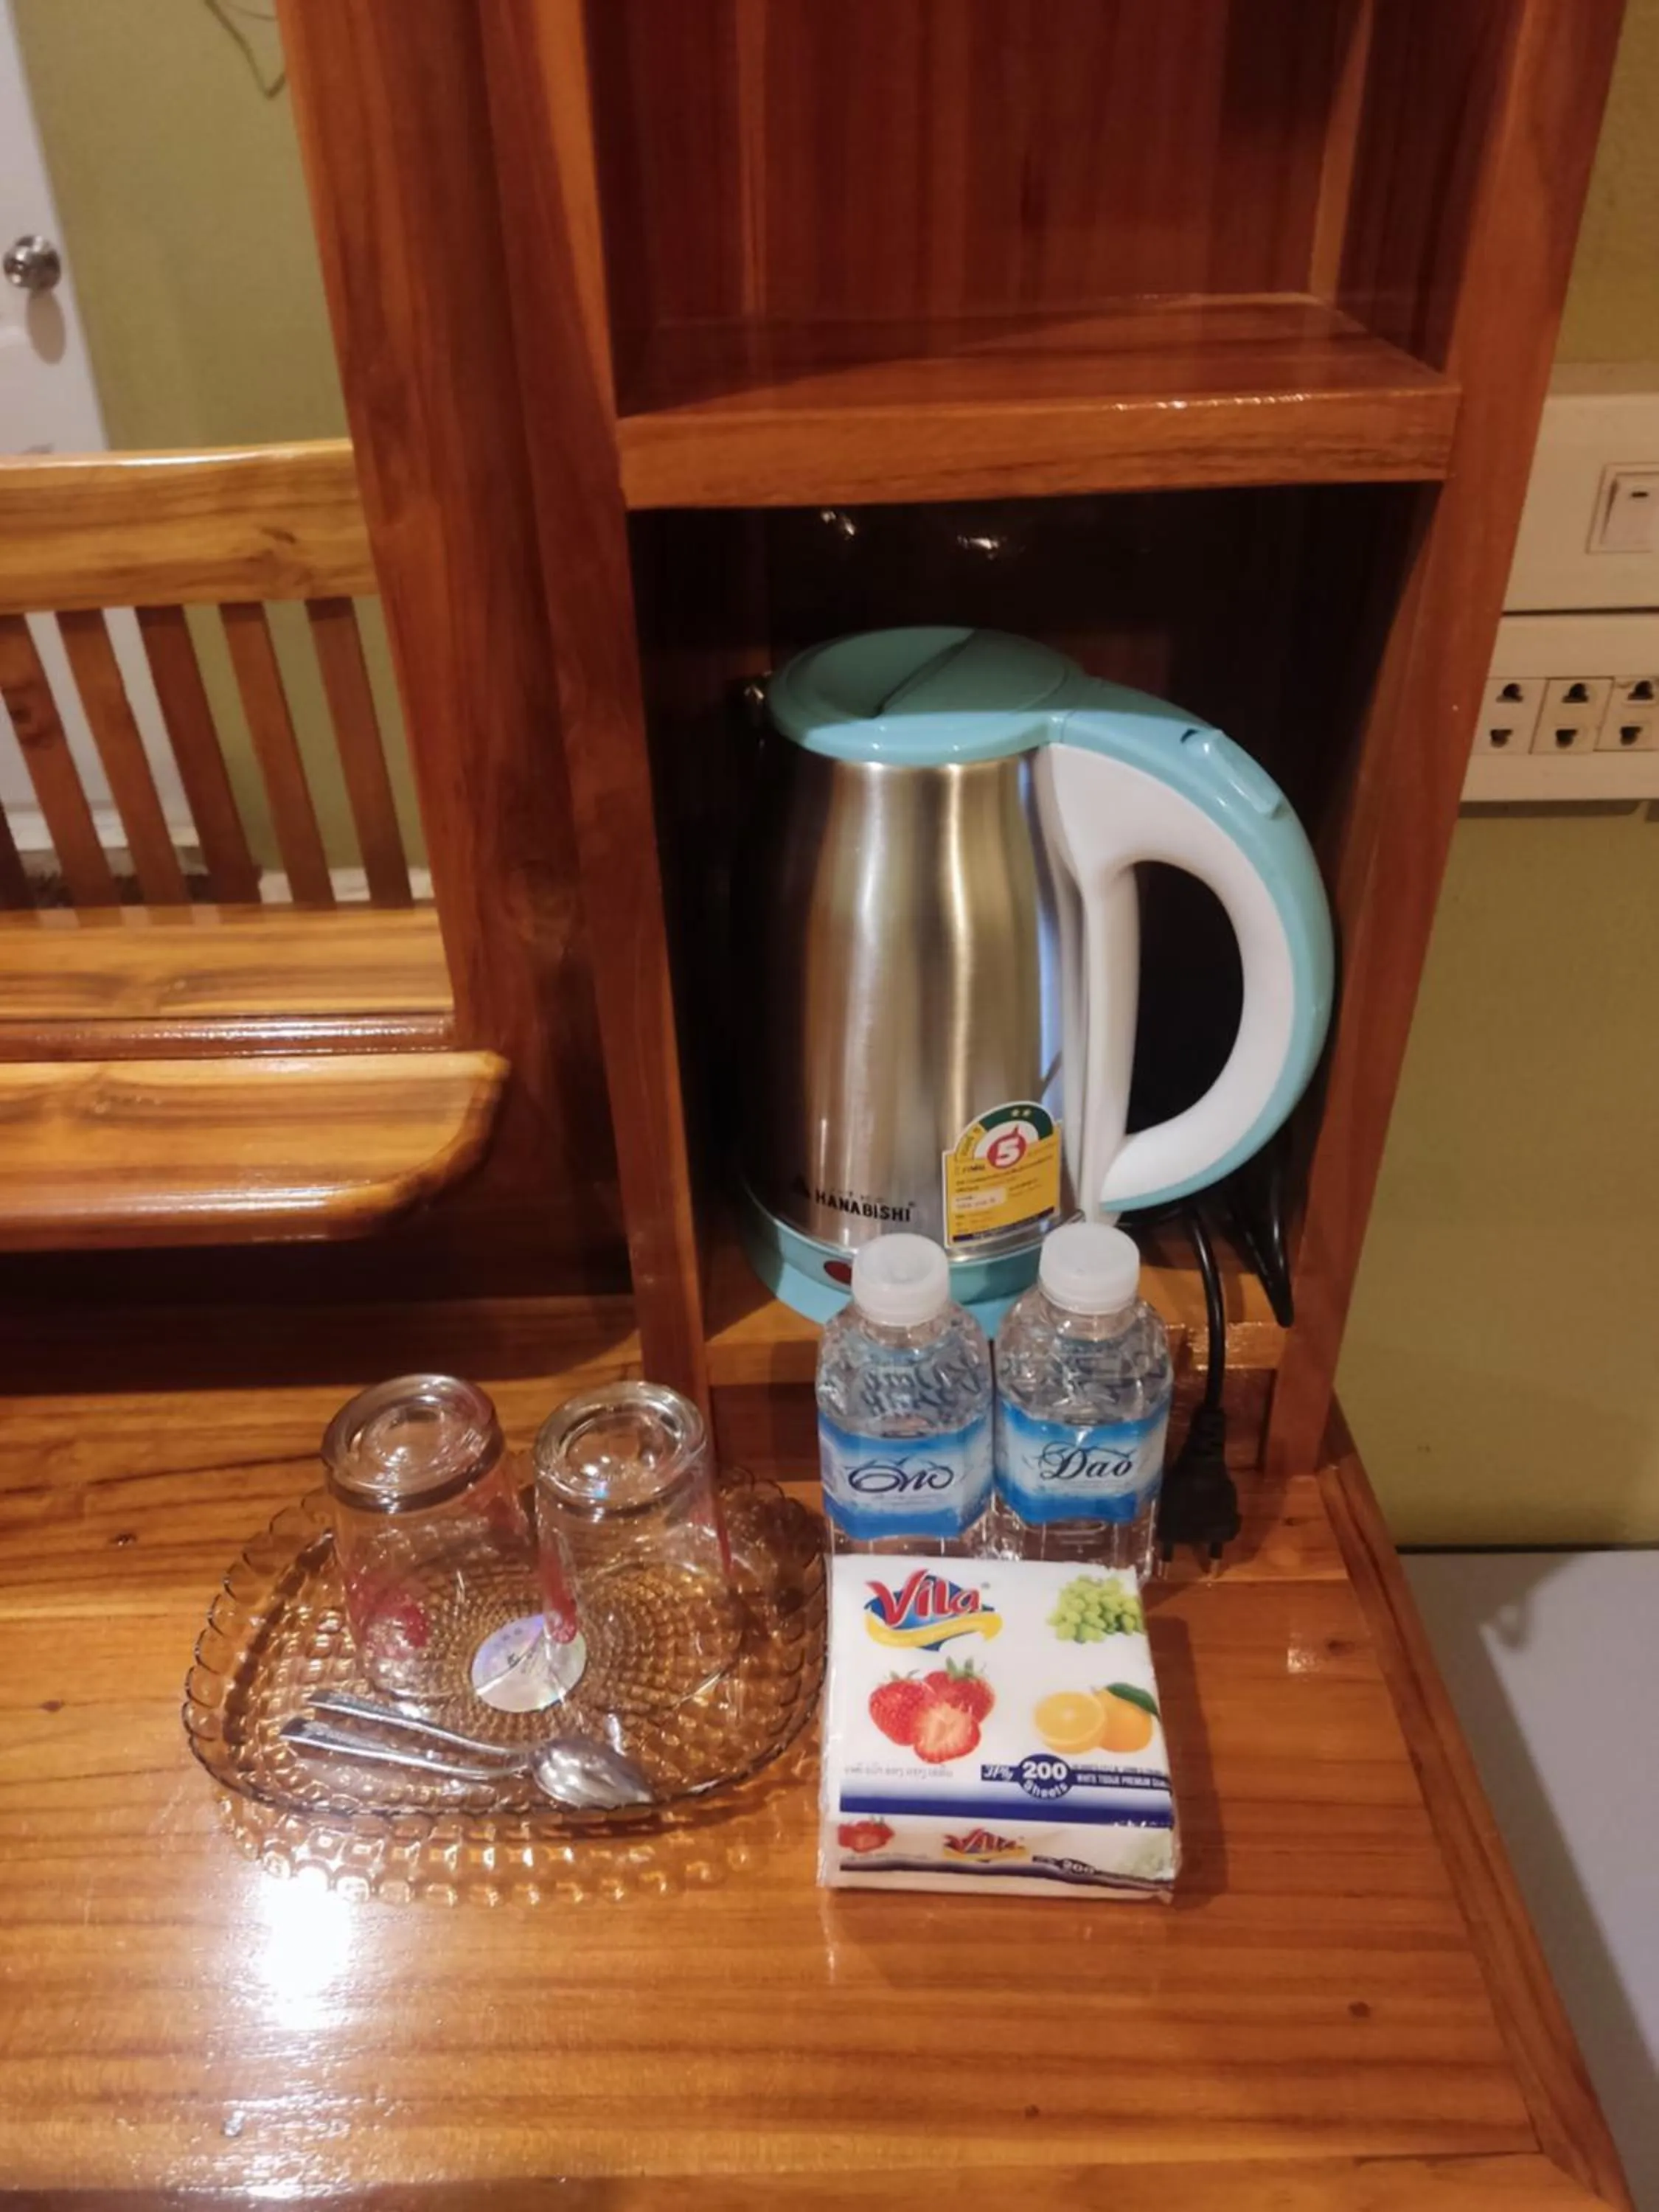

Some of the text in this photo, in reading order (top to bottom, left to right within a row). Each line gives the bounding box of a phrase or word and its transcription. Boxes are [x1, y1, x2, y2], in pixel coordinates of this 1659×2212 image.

[995, 1136, 1024, 1169] 5
[815, 1189, 911, 1222] HANABISHI
[1037, 1441, 1133, 1481] Dao
[866, 1568, 980, 1628] Vila
[1022, 1761, 1068, 1781] 200
[1023, 1780, 1068, 1798] Sheets
